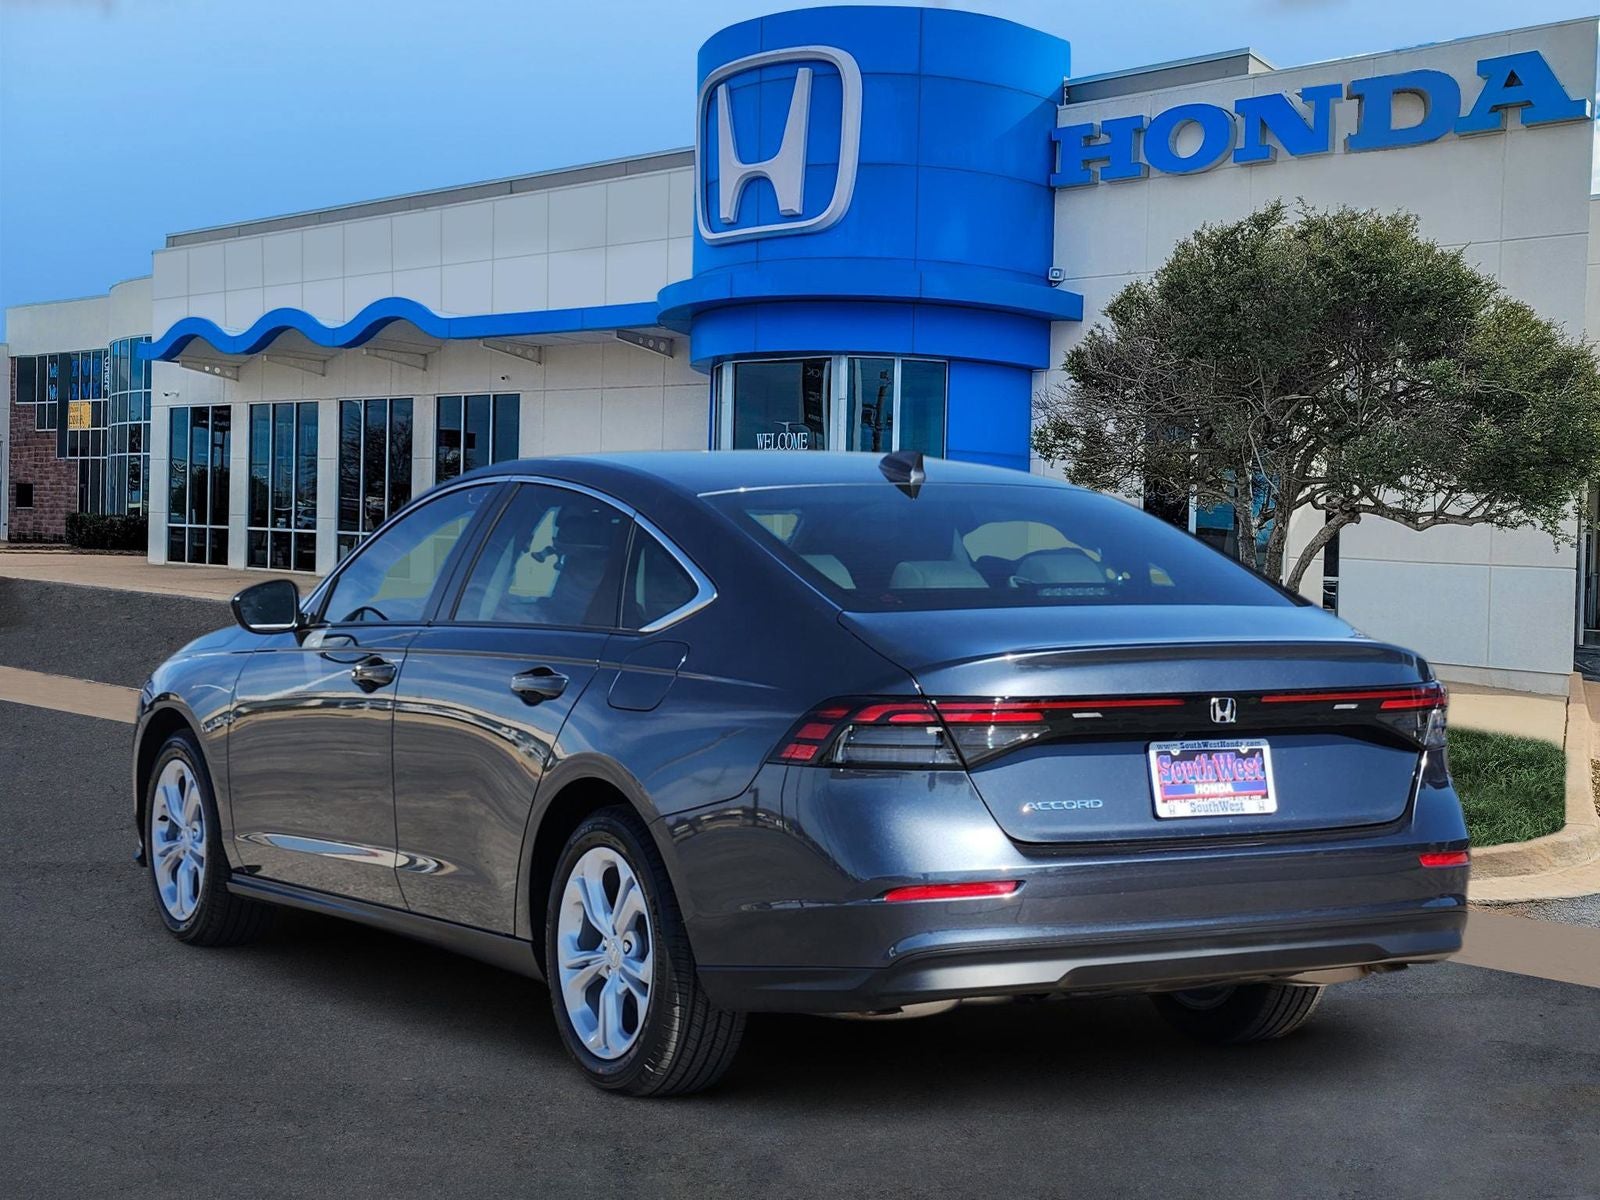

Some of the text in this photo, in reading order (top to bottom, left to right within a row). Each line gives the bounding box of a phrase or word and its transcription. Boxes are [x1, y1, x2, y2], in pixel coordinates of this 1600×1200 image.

[1051, 50, 1591, 188] HONDA
[756, 431, 808, 450] WELCOME
[1157, 751, 1265, 784] SouthWest
[1195, 781, 1233, 795] HONDA
[1022, 799, 1104, 813] ACCORD
[1190, 801, 1246, 814] SouthWest
